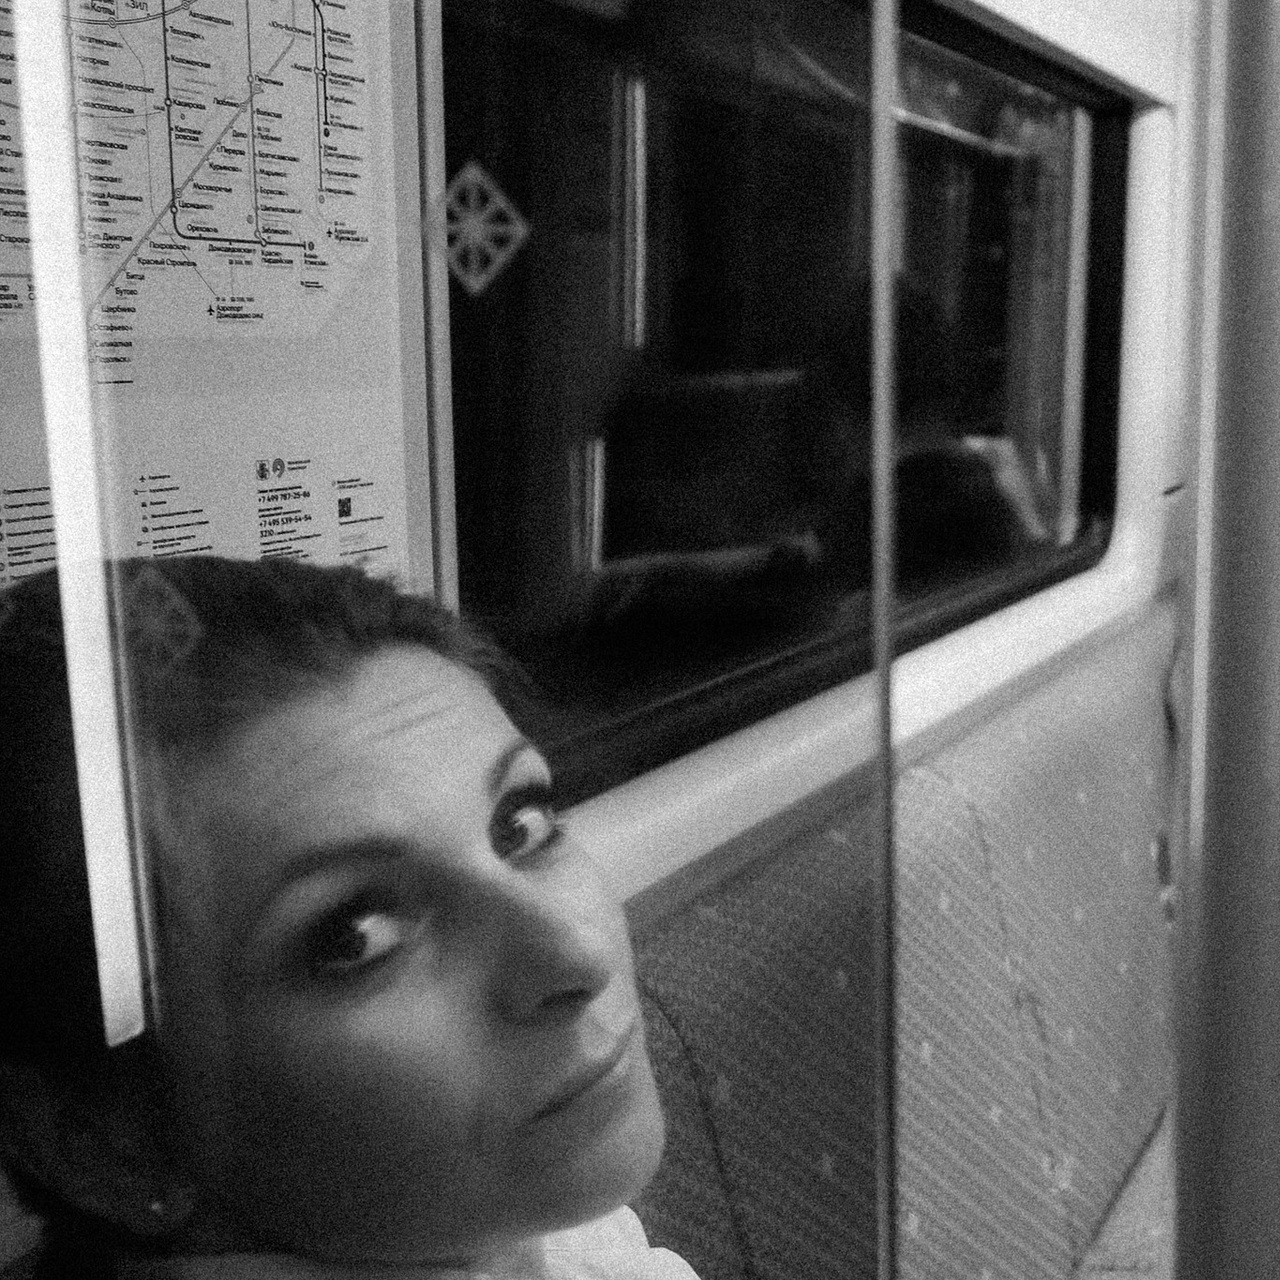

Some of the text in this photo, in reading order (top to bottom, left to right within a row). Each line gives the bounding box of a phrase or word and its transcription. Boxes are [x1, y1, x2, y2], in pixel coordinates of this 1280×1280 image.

[91, 1, 115, 16] Котлы
[130, 0, 148, 12] ЗИЛ
[115, 286, 139, 296] Бутово
